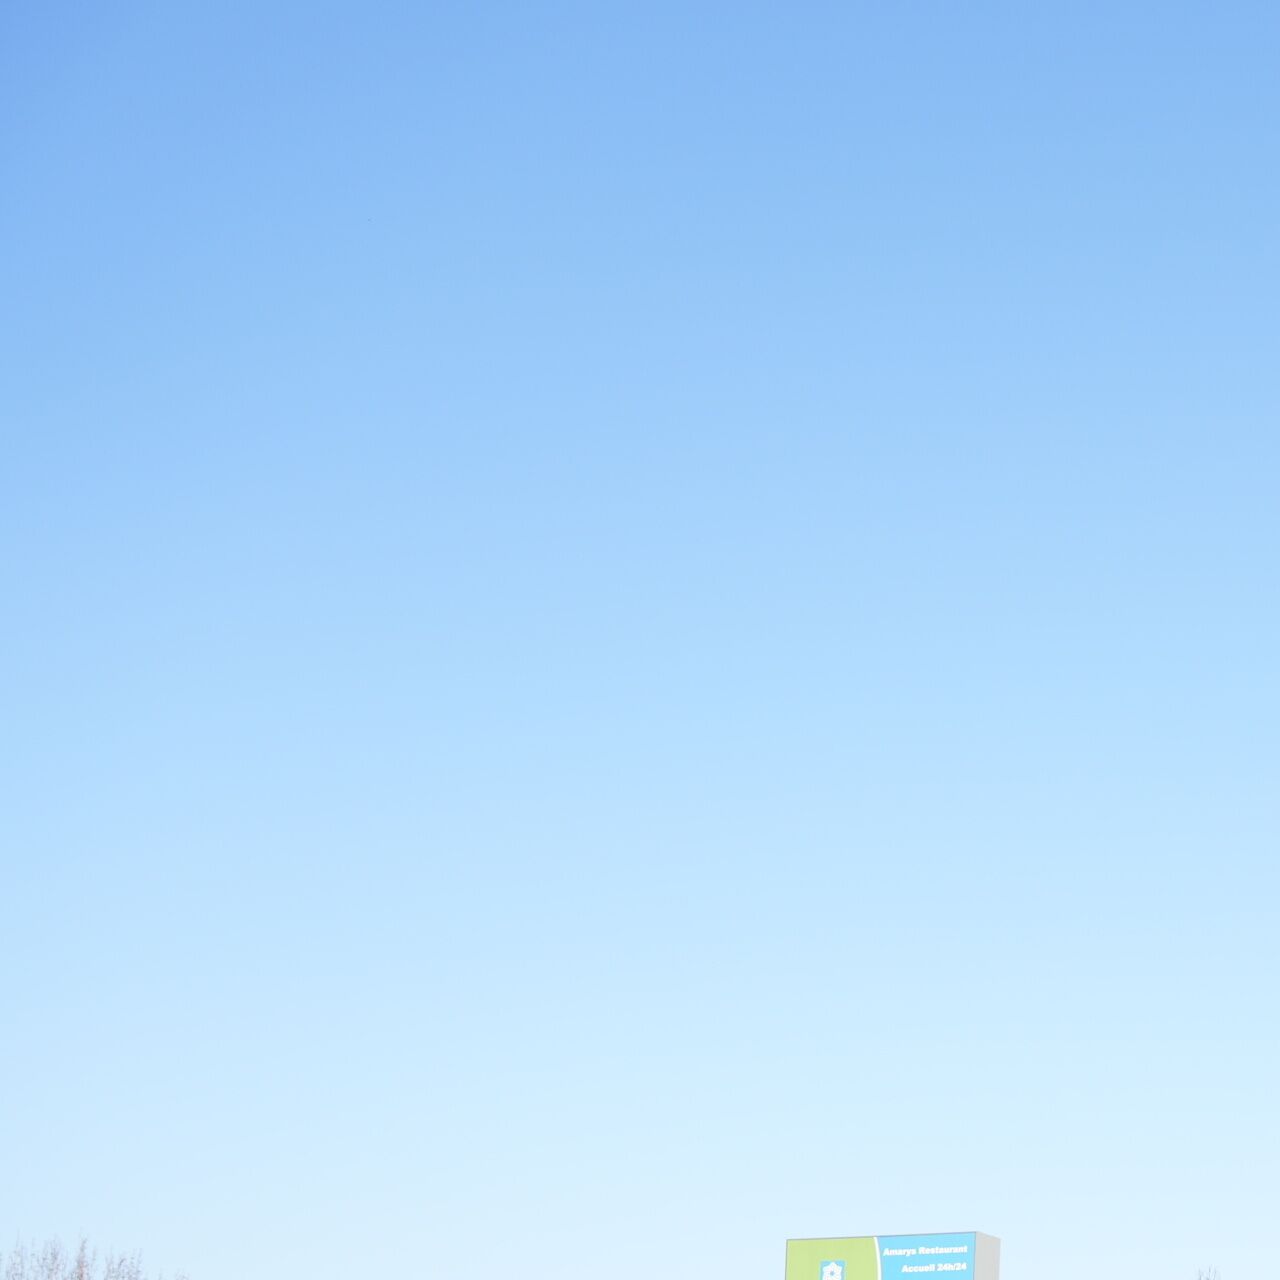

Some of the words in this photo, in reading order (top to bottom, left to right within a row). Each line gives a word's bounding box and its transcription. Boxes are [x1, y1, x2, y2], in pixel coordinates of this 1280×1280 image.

[883, 1248, 916, 1257] Amarys
[918, 1245, 968, 1254] Restaurant
[901, 1264, 935, 1273] Accueil
[937, 1262, 967, 1271] 24h/24
